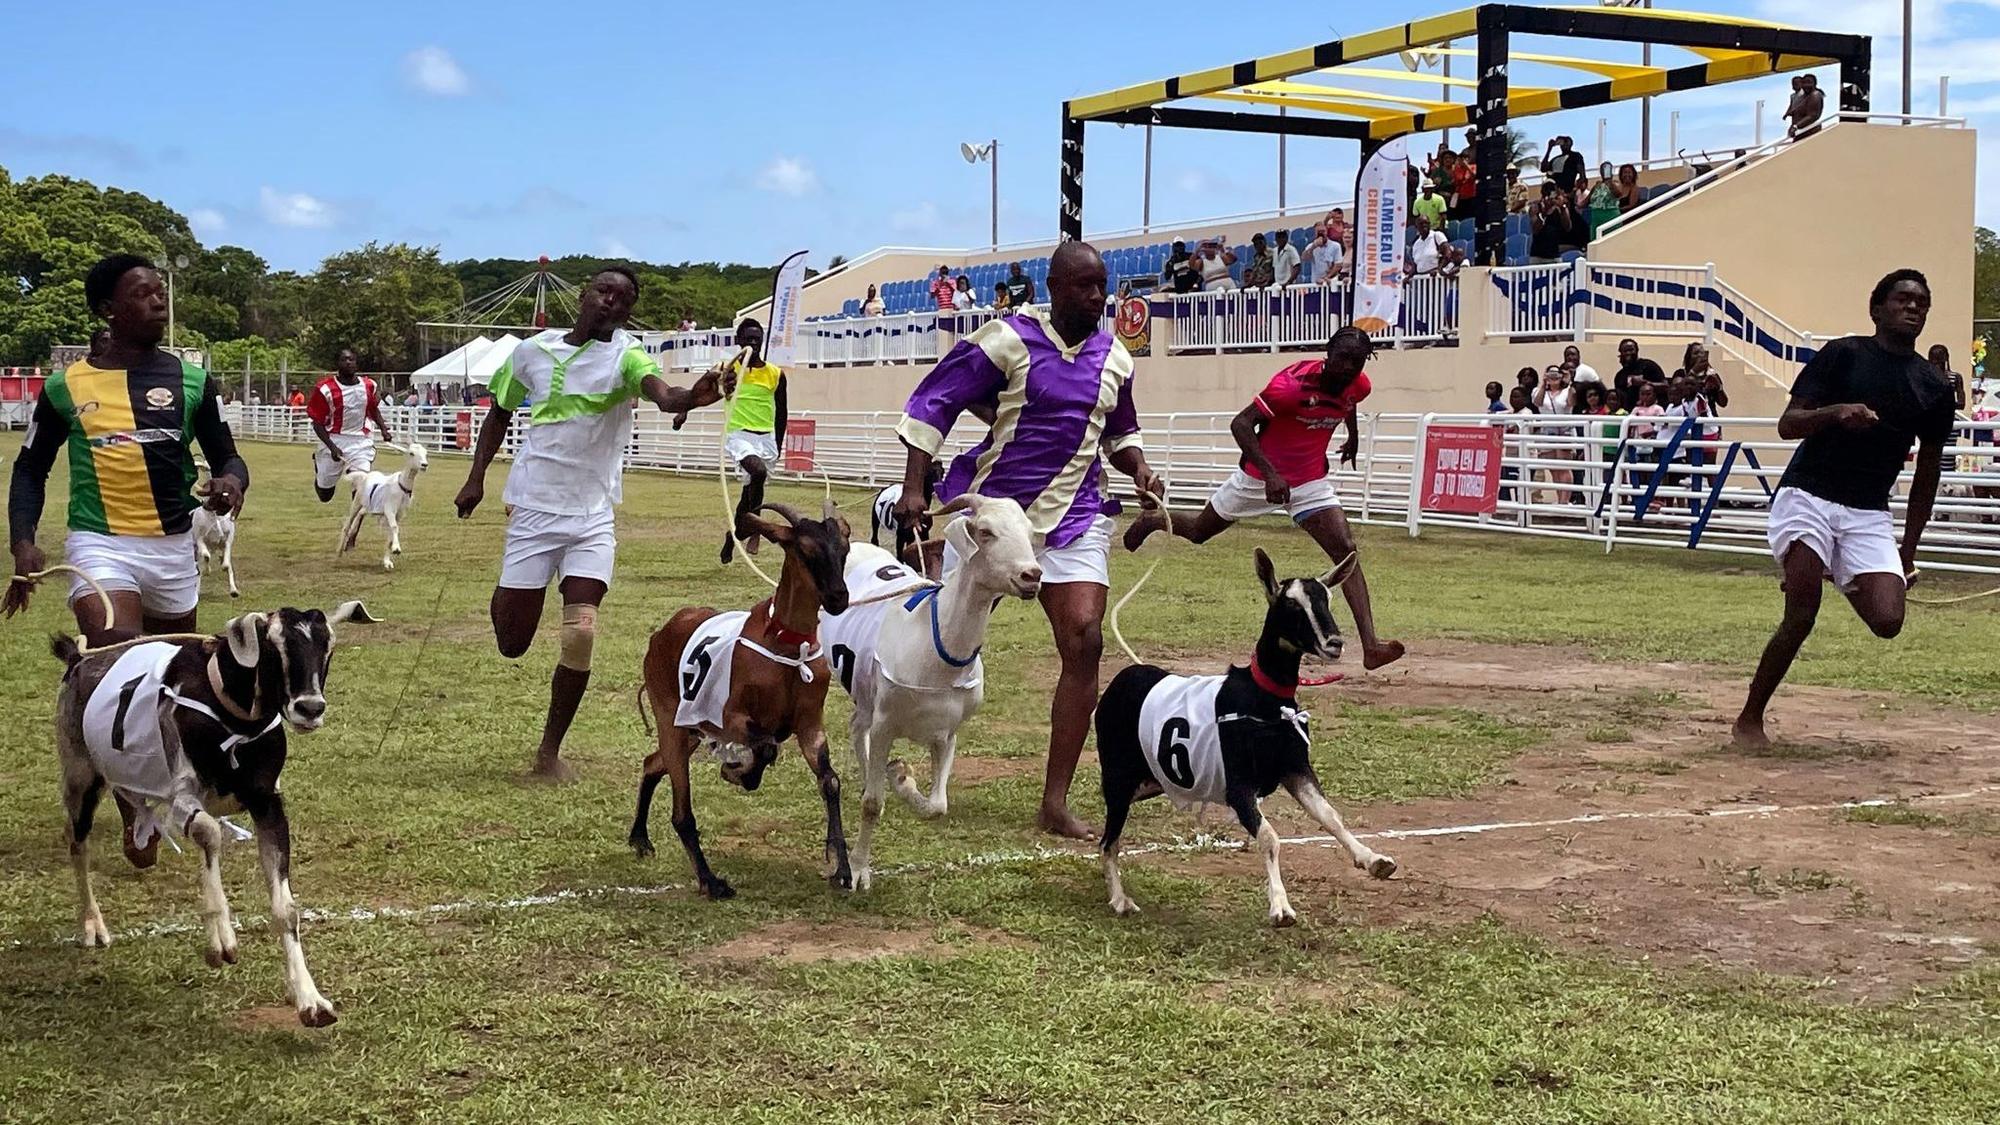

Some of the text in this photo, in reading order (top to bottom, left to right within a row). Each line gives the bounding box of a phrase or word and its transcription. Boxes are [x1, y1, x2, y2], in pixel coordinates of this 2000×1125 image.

[1366, 188, 1378, 286] CREDIT UNION
[1381, 189, 1395, 263] LAMBEAU
[1446, 473, 1456, 496] TO
[682, 636, 720, 701] 5
[111, 672, 148, 752] 1
[1157, 717, 1195, 789] 6
